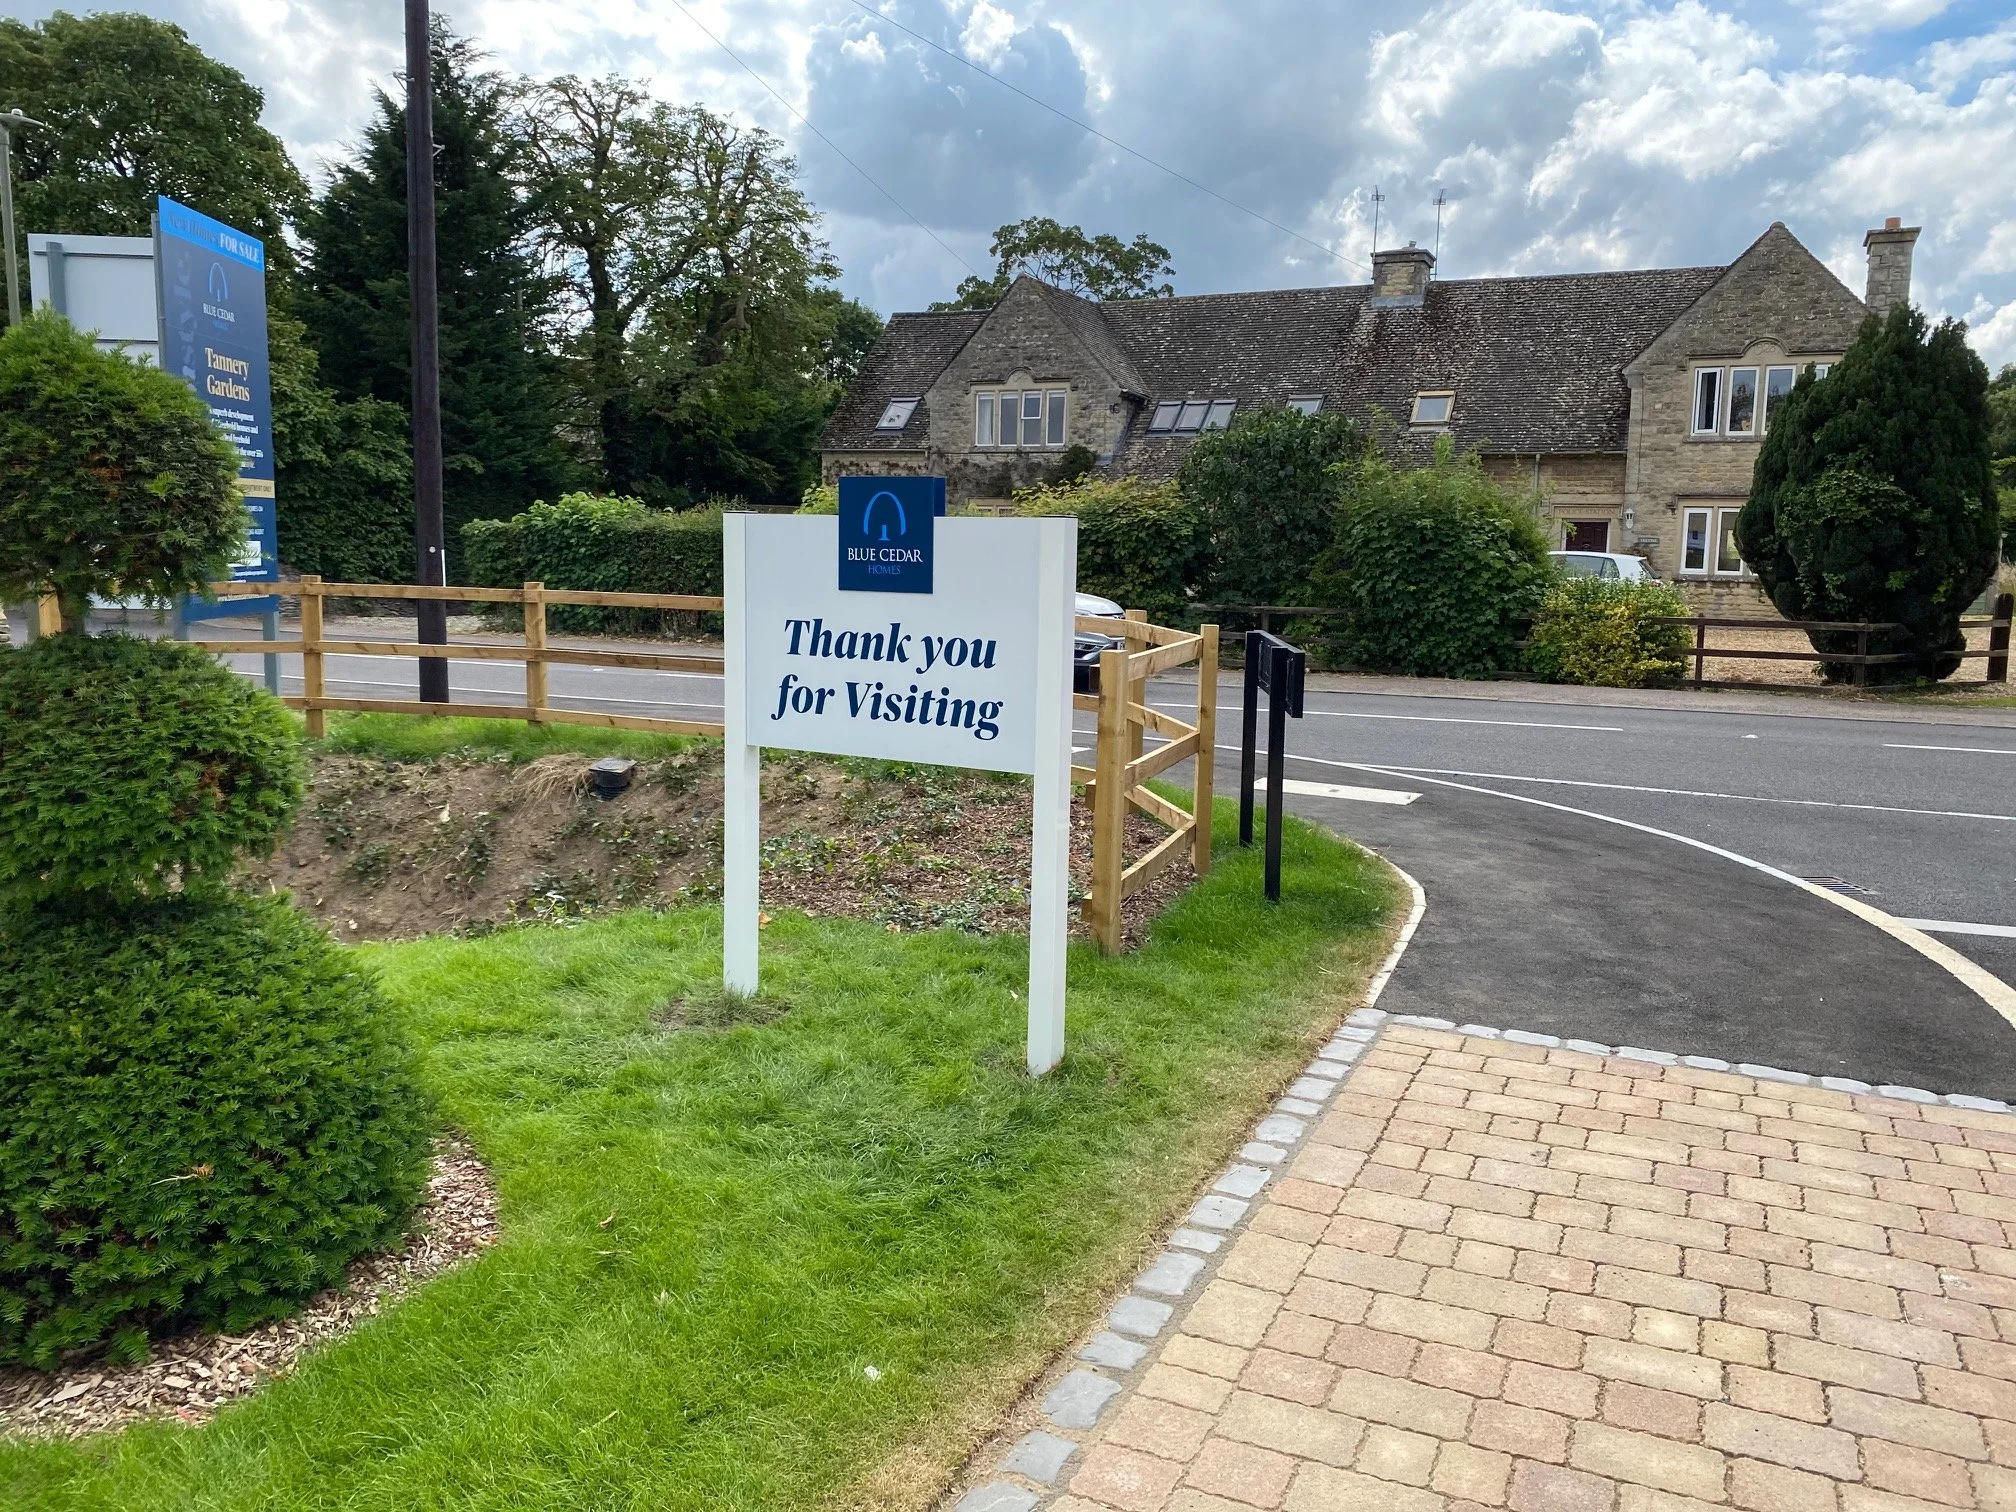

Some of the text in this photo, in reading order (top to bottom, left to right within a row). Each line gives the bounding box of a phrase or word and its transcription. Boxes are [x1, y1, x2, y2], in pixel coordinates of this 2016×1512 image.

[220, 232, 238, 254] FOR
[239, 241, 260, 263] SALE
[203, 302, 235, 323] BLUE CEDAR
[204, 347, 250, 381] Tannery
[206, 374, 250, 402] Gardens
[848, 547, 924, 563] BLUE CEDAR
[868, 564, 901, 575] HOMES
[784, 618, 997, 675] Thank you
[770, 674, 1004, 741] for Visiting
